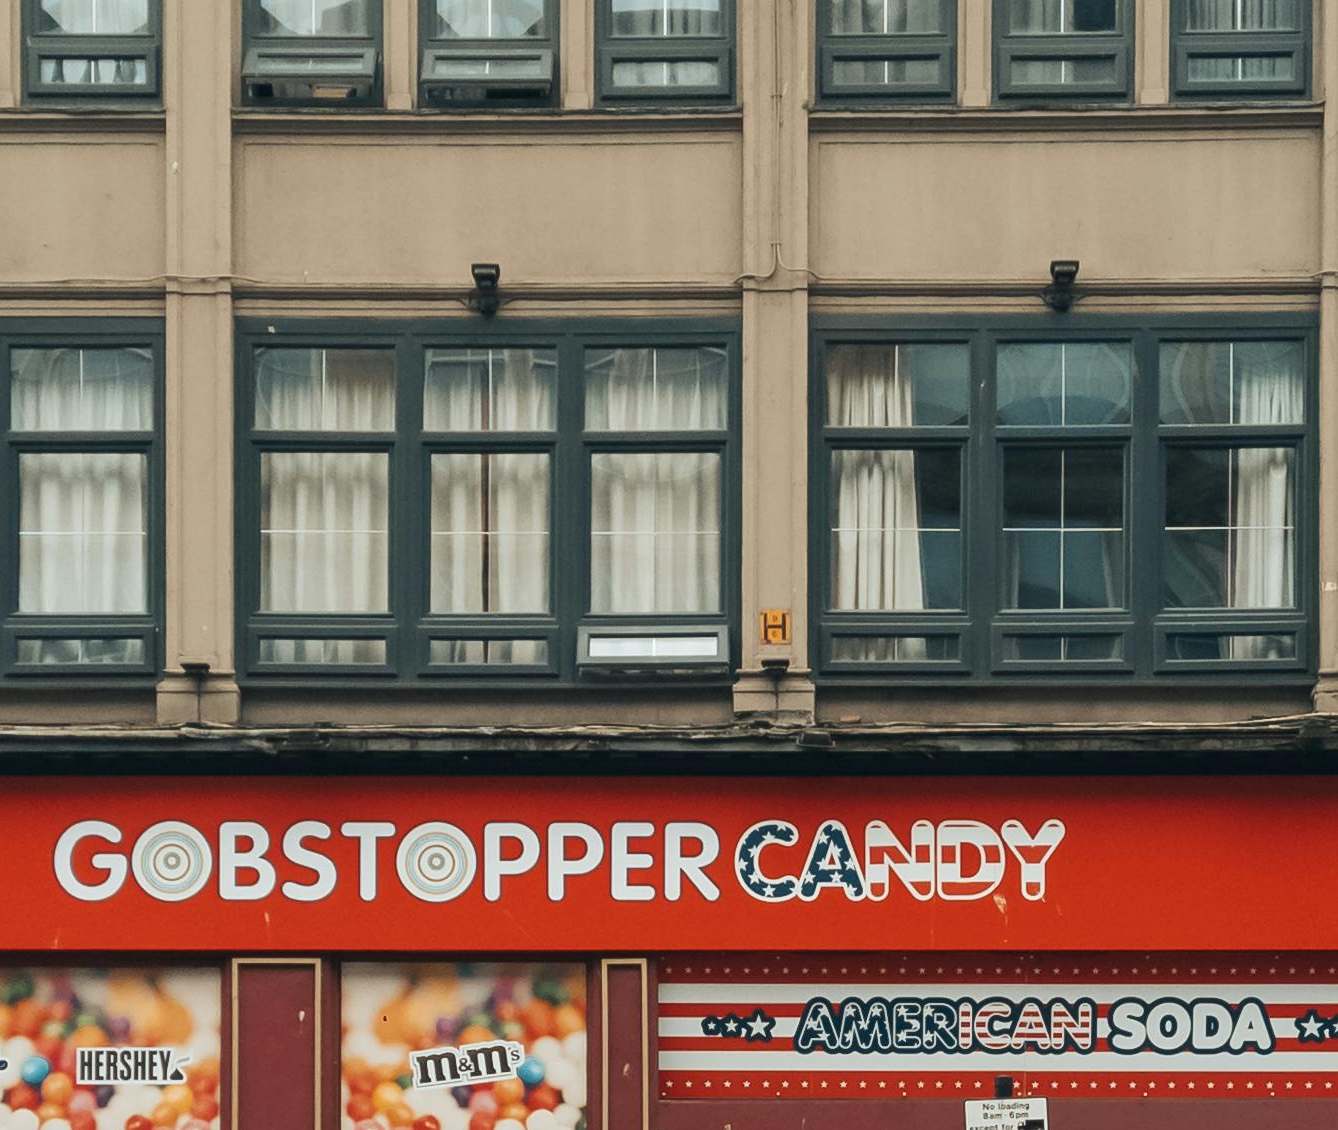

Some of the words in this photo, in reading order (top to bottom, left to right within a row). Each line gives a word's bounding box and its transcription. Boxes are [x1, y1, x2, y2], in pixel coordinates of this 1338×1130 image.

[733, 818, 1067, 903] CANDY
[795, 999, 1095, 1052] AMERICAN
[1110, 999, 1273, 1052] SODA
[982, 1103, 996, 1111] No
[997, 1102, 1030, 1111] loading
